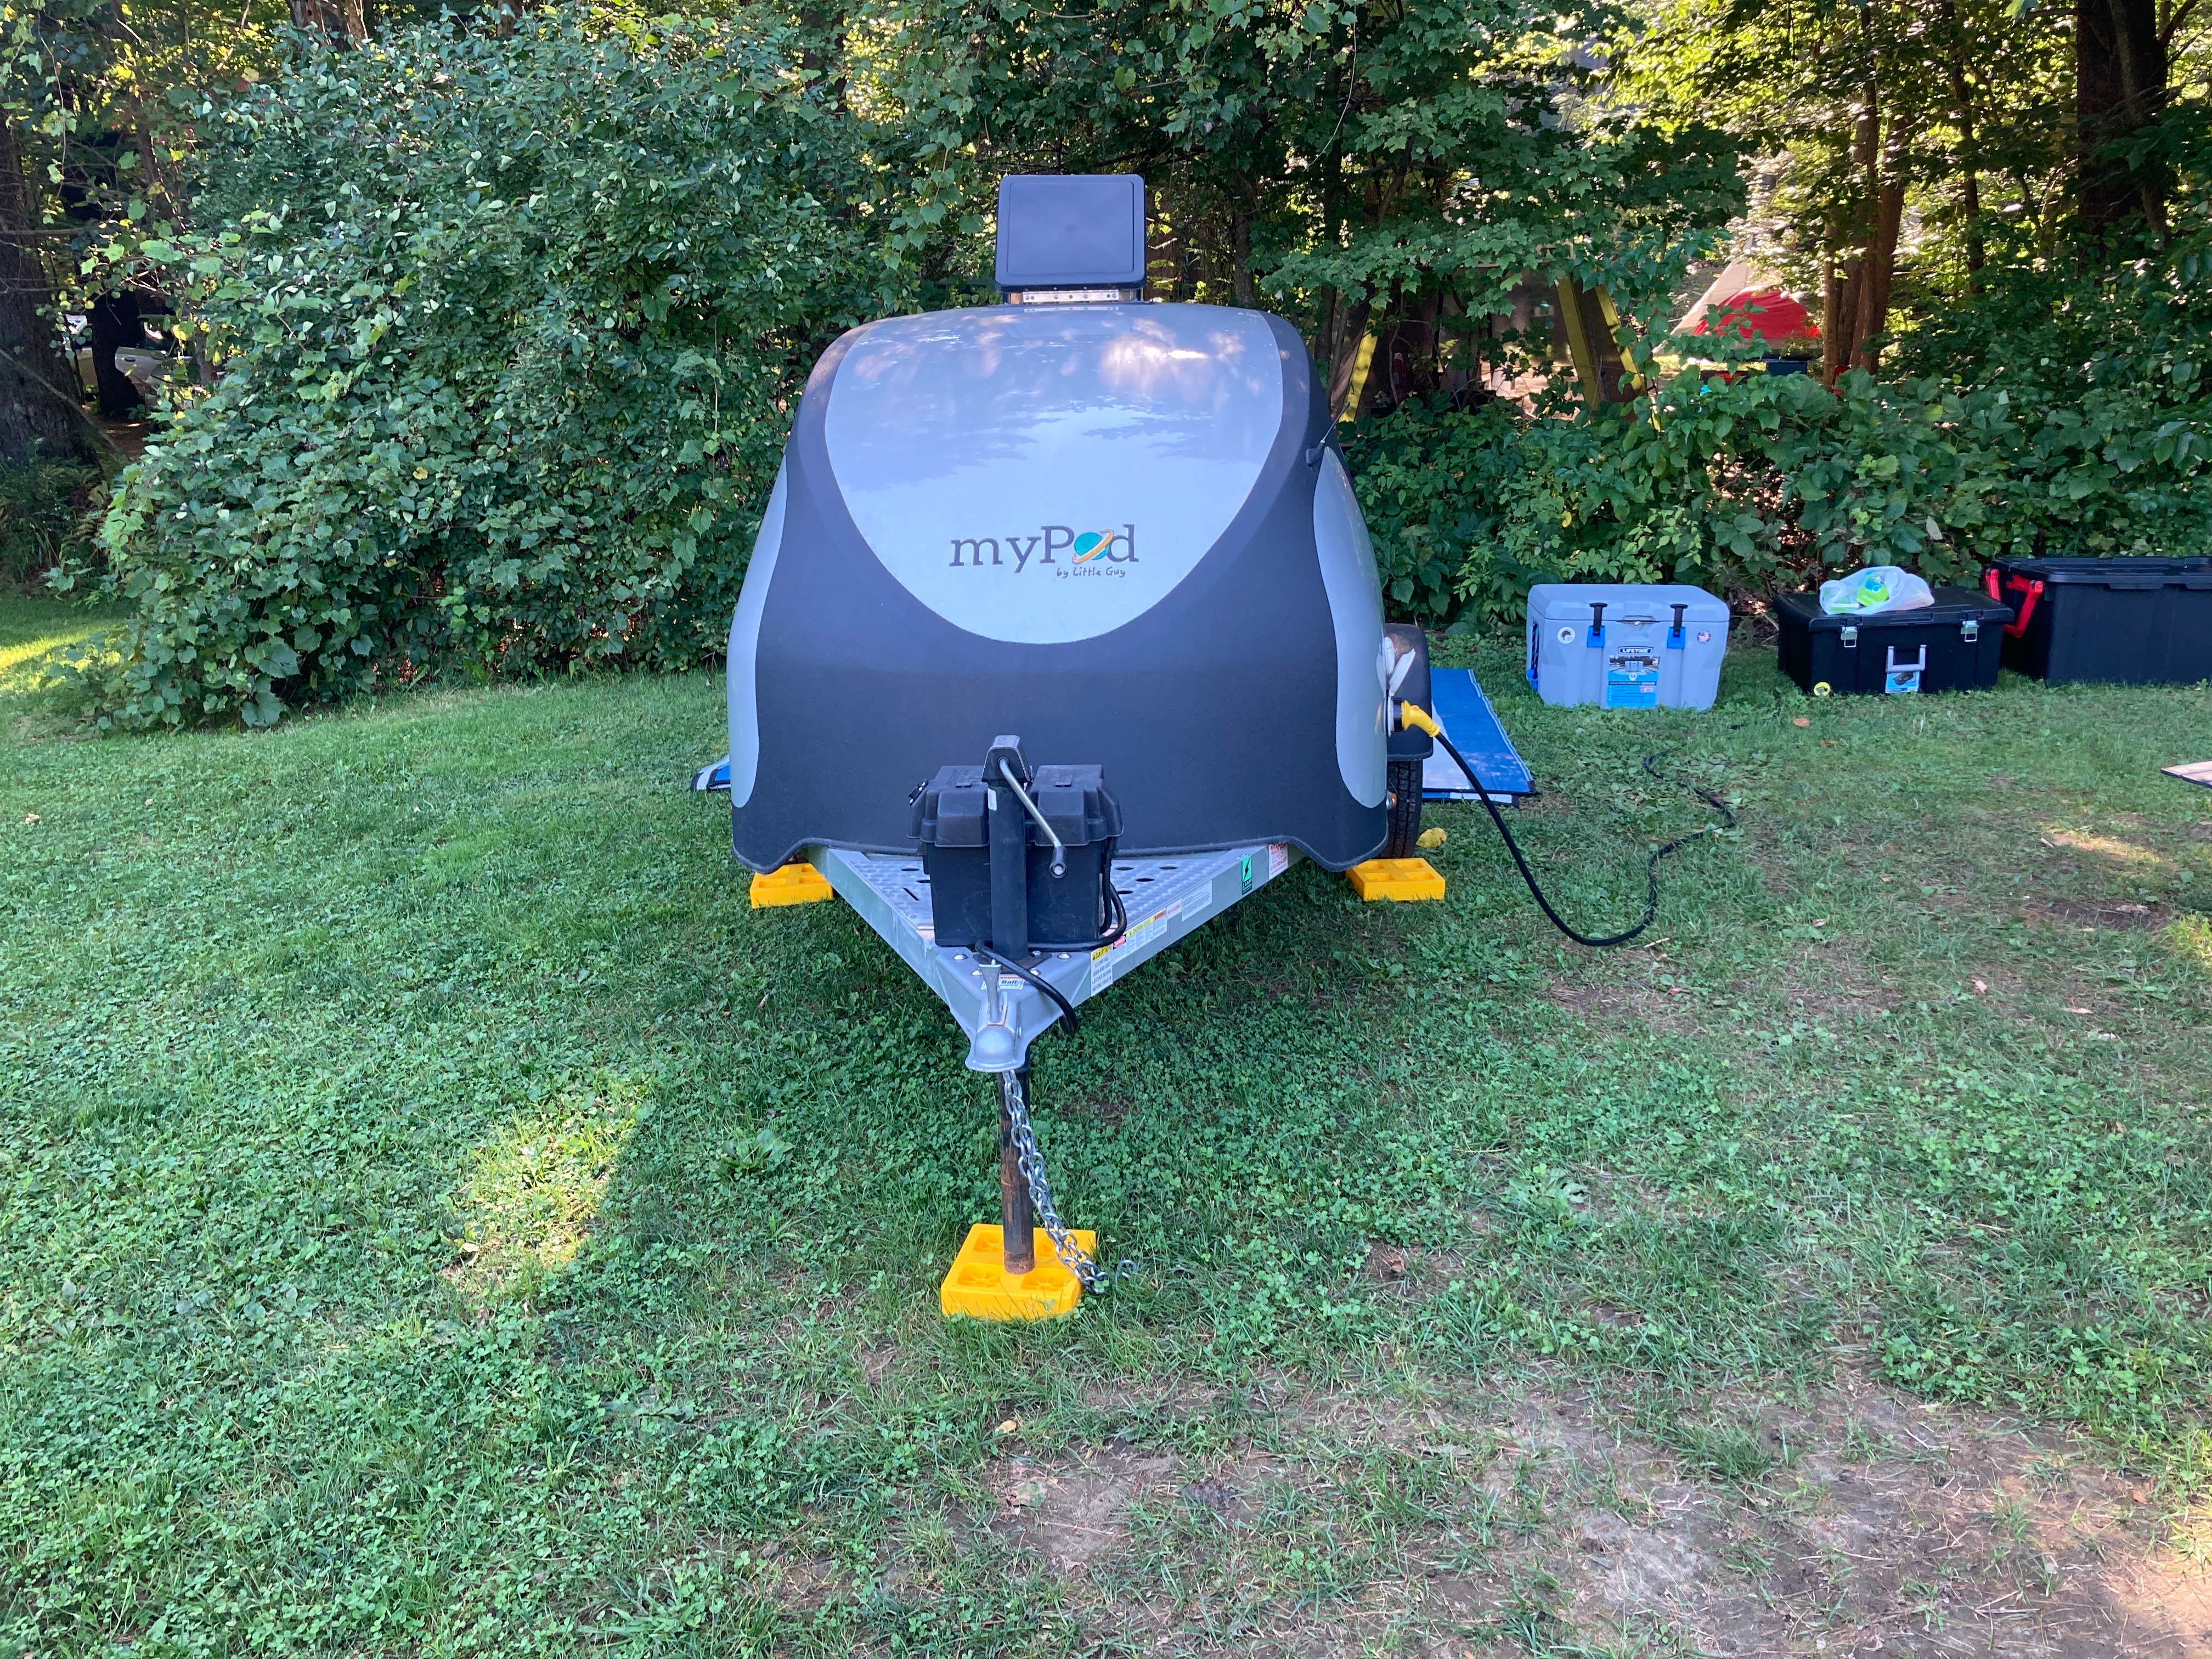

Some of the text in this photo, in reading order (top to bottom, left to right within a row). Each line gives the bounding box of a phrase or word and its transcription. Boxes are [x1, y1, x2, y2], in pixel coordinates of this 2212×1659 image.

[1057, 566, 1126, 578] by Little Guy
[1096, 945, 1111, 957] CAUTION
